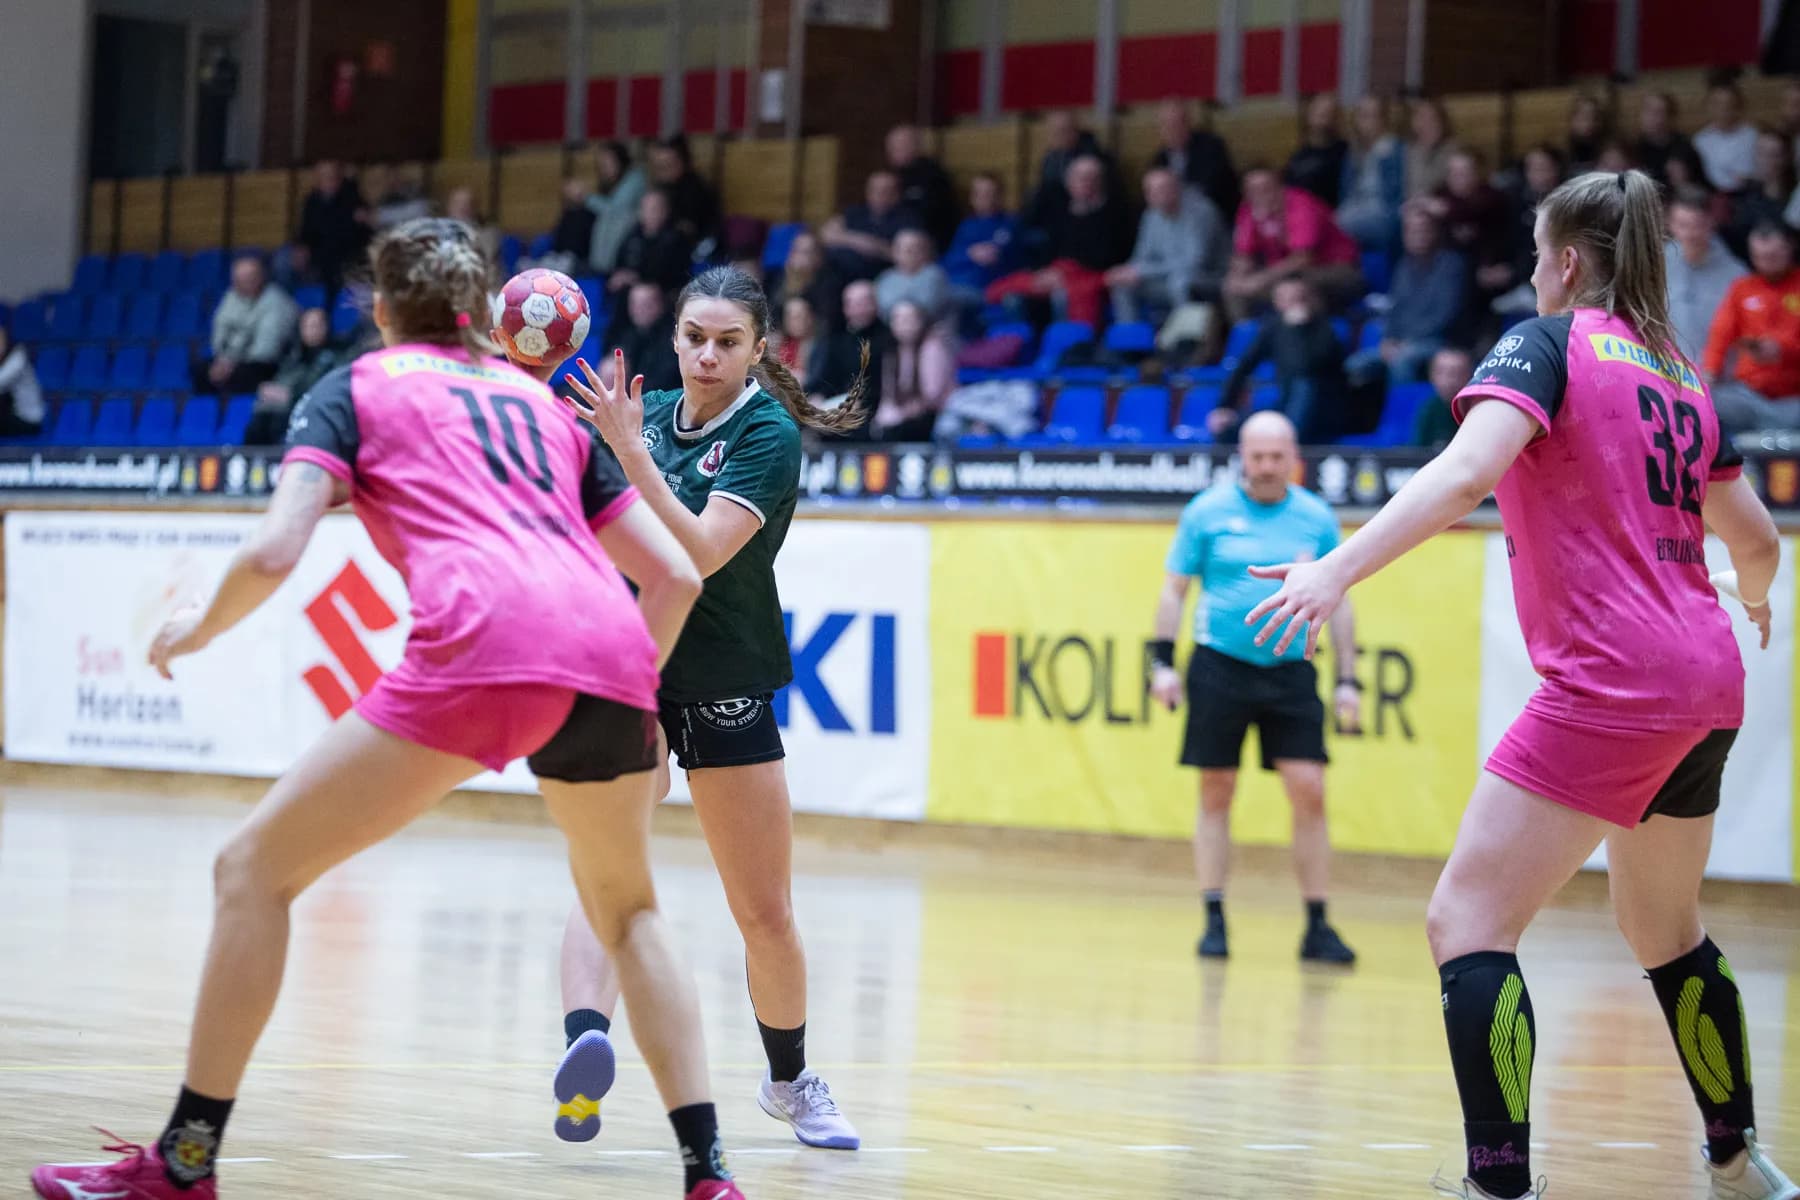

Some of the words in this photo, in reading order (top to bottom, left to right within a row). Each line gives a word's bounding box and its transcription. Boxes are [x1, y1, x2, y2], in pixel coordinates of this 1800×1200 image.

[1474, 357, 1531, 373] OFIKA
[1628, 344, 1700, 390] LEWAN
[448, 386, 554, 493] 10
[1637, 384, 1704, 517] 32
[716, 718, 736, 727] YOUR
